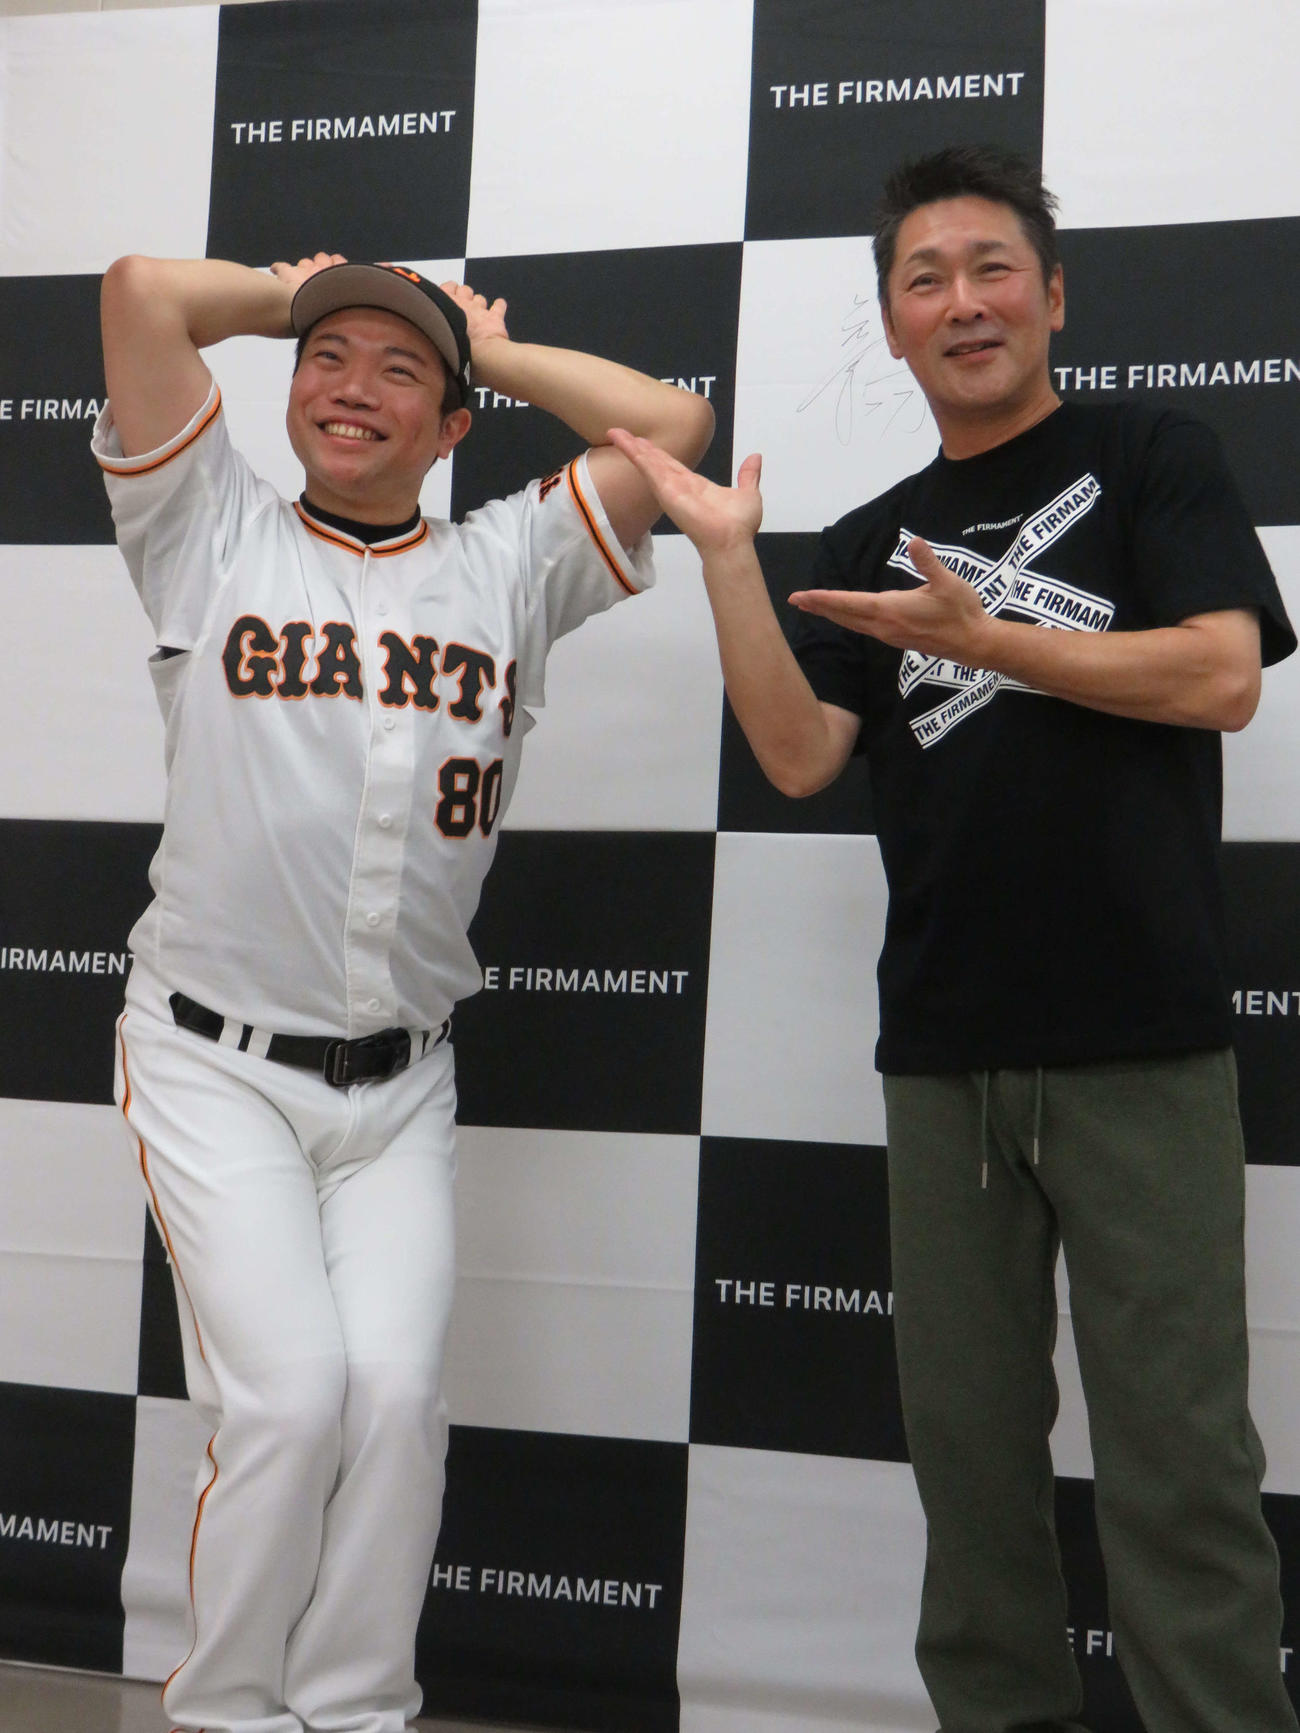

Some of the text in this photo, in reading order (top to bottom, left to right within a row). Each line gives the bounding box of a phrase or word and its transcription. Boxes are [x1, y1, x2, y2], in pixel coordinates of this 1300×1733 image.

[770, 72, 1025, 108] THE FIRMAMENT
[231, 110, 457, 144] THE FIRMAMENT
[1053, 358, 1300, 390] THE FIRMAMEN
[20, 398, 102, 420] FIRMA
[1008, 534, 1034, 570] THE
[913, 716, 942, 741] THE
[508, 966, 689, 995] FIRMAMENT
[715, 1278, 894, 1316] THE FIRMA
[0, 1512, 113, 1550] MAMENT
[432, 1563, 663, 1609] HE FIRMAMENT
